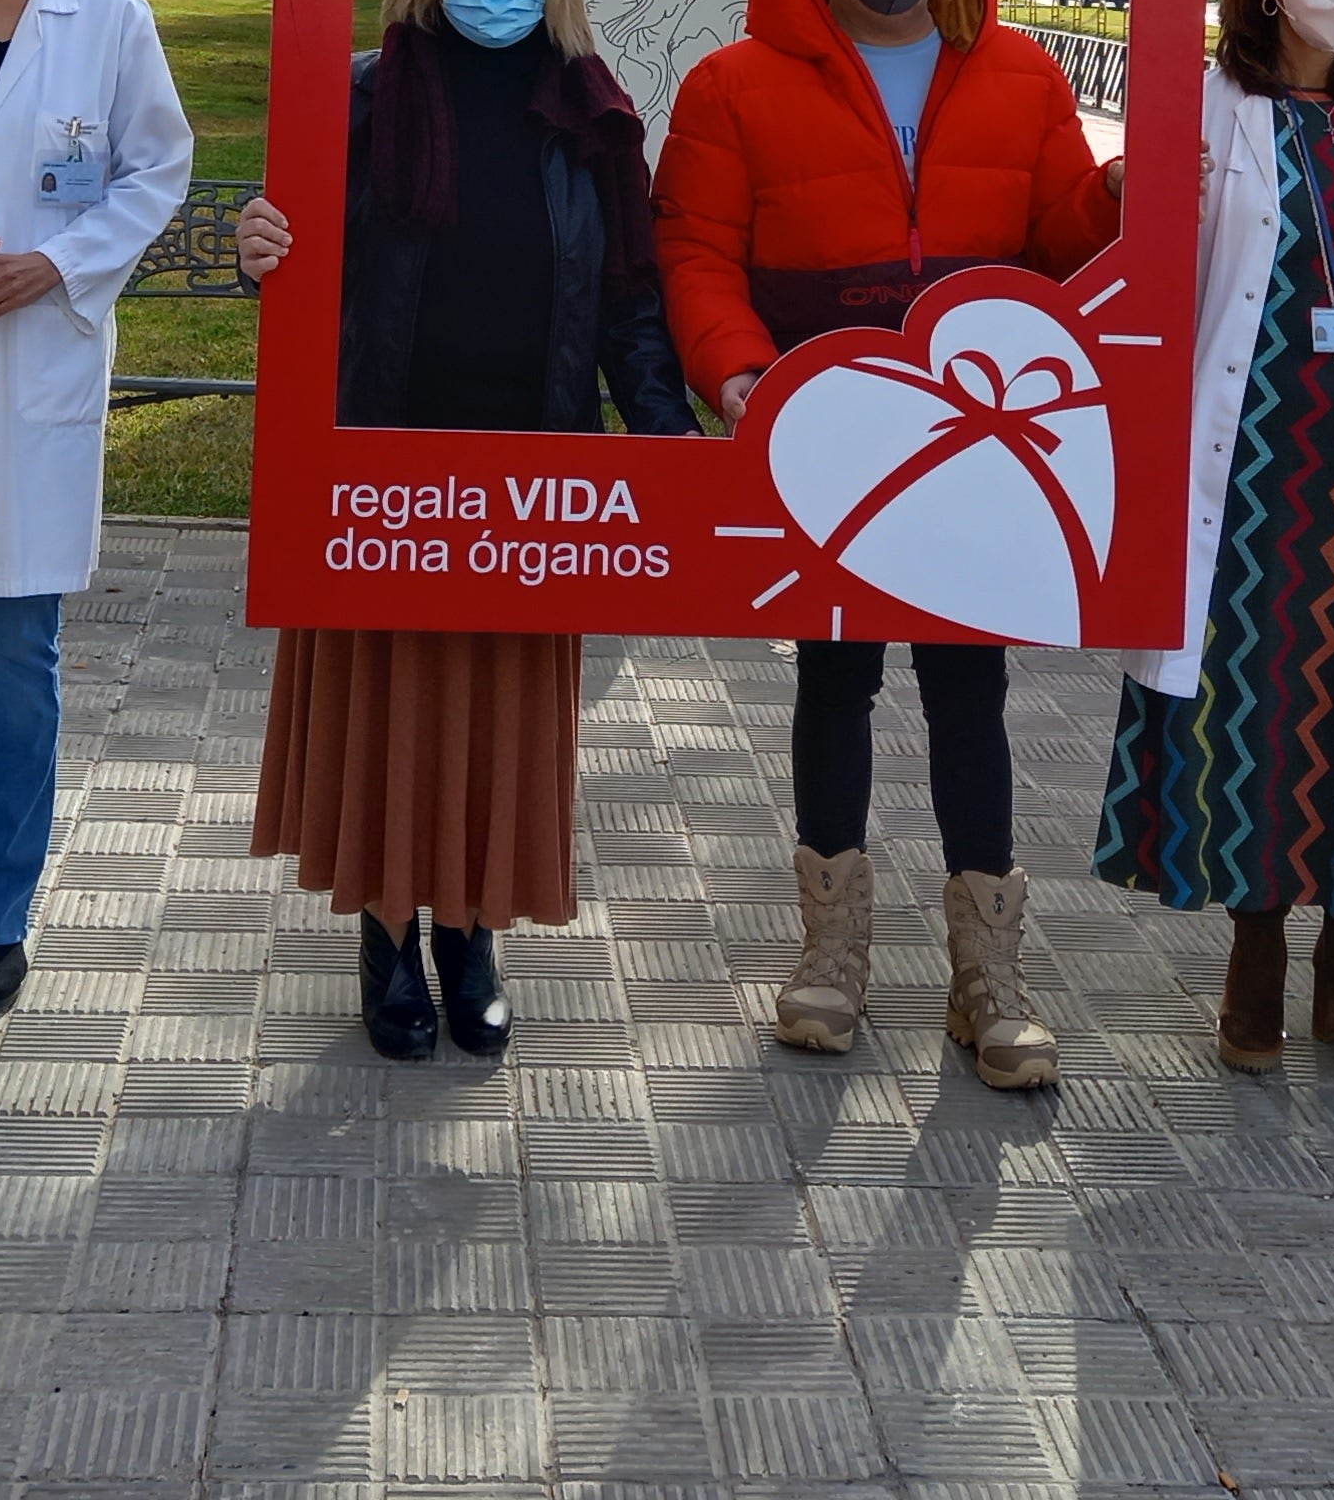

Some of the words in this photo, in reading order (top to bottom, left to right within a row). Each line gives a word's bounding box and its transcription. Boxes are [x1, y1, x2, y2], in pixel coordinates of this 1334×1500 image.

[331, 475, 487, 530] regala
[505, 477, 640, 524] VIDA
[325, 527, 449, 572] dona
[468, 530, 670, 586] órganos
